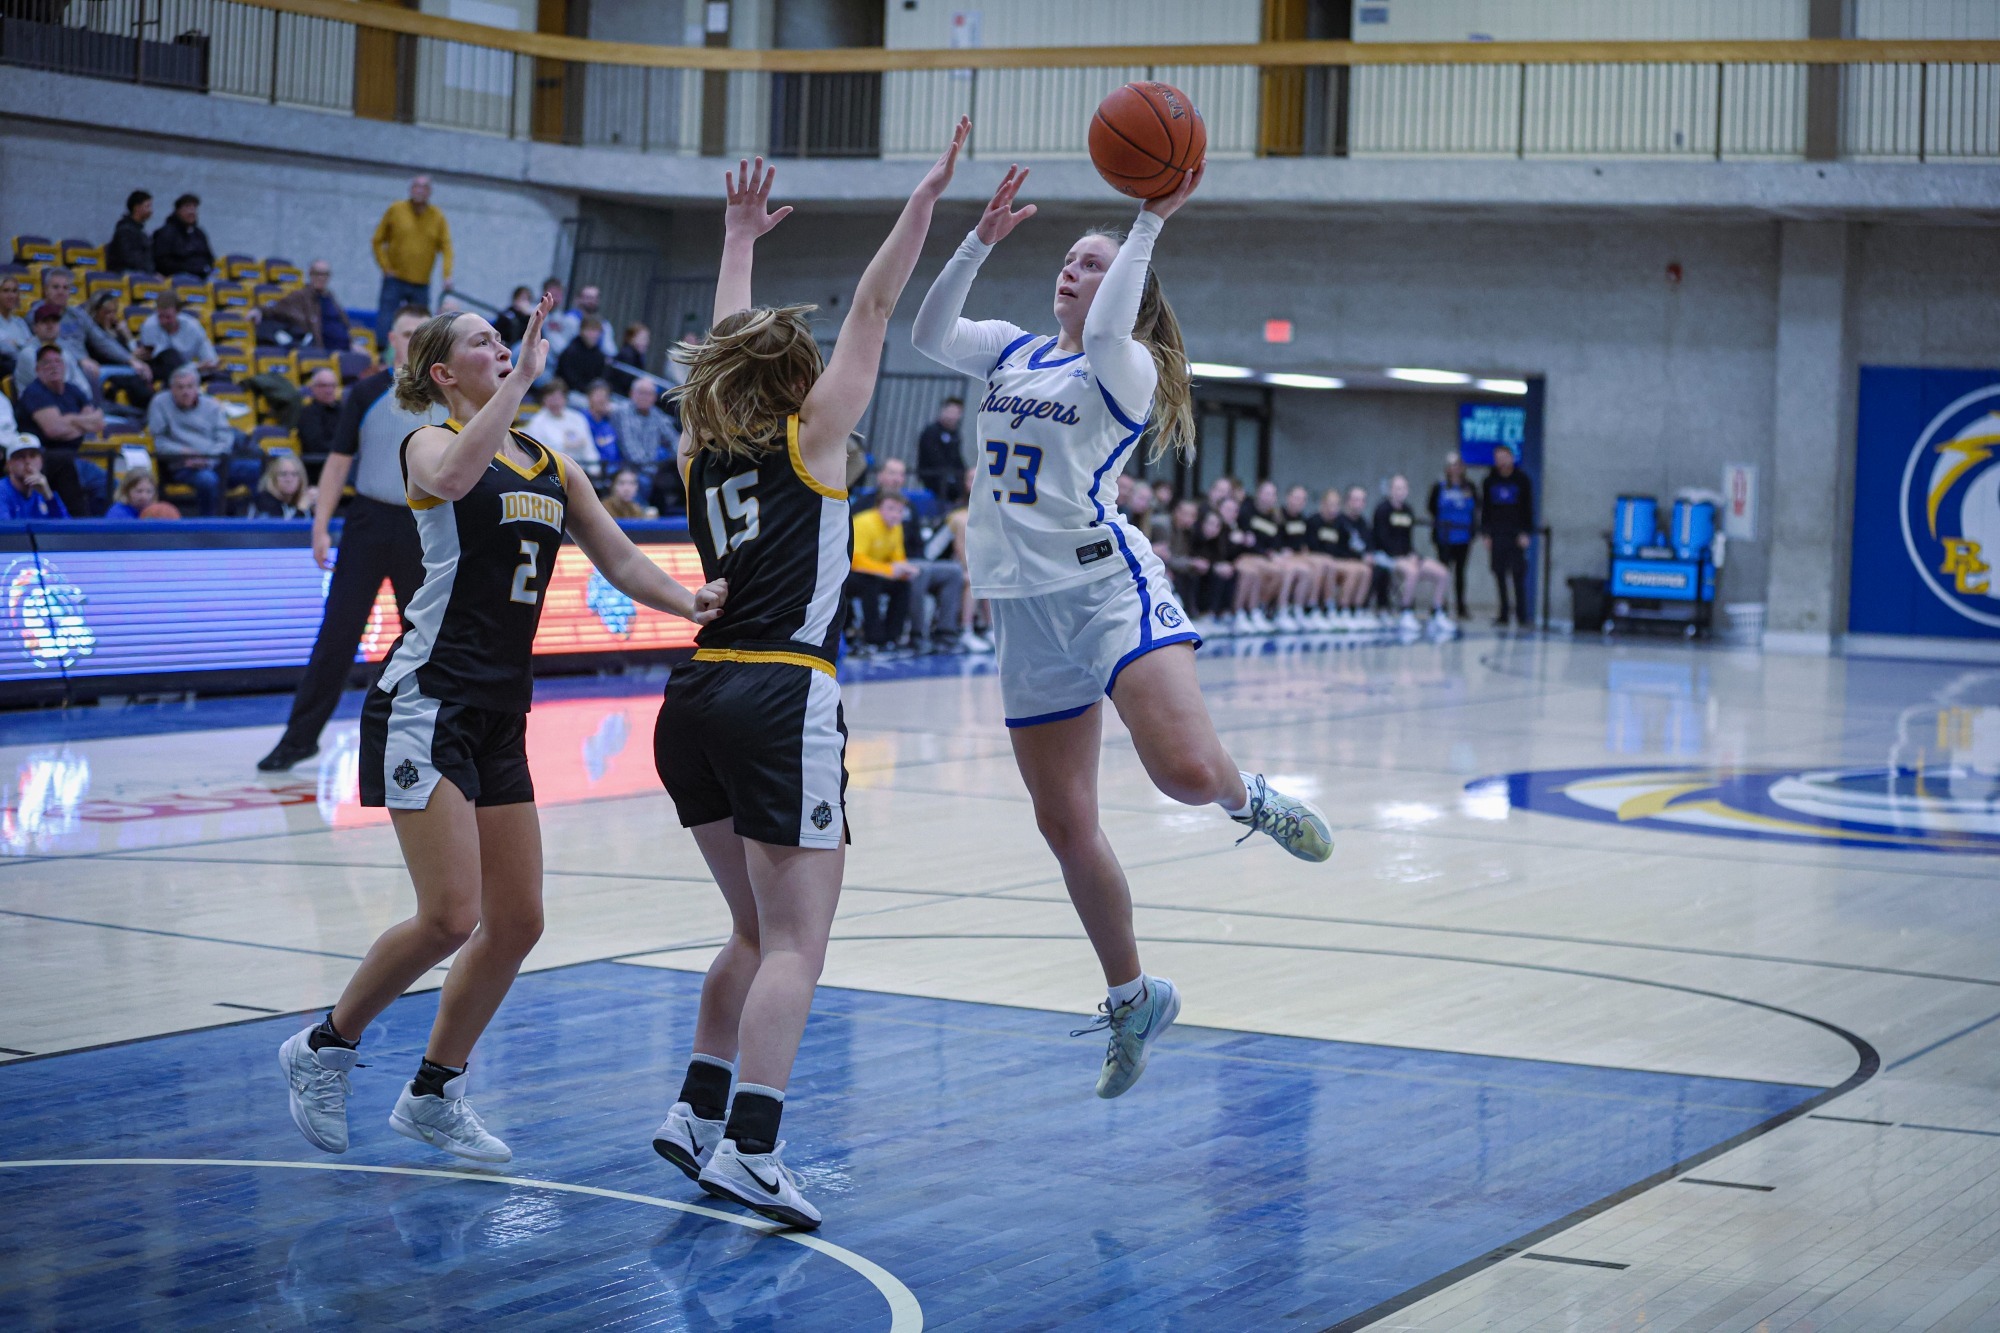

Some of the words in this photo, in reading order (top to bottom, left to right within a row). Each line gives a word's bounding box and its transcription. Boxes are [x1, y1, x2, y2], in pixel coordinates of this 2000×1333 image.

[979, 381, 1081, 430] hargers
[986, 439, 1043, 506] 23
[503, 492, 564, 530] DORDT
[705, 468, 760, 560] 15
[509, 539, 540, 605] 2
